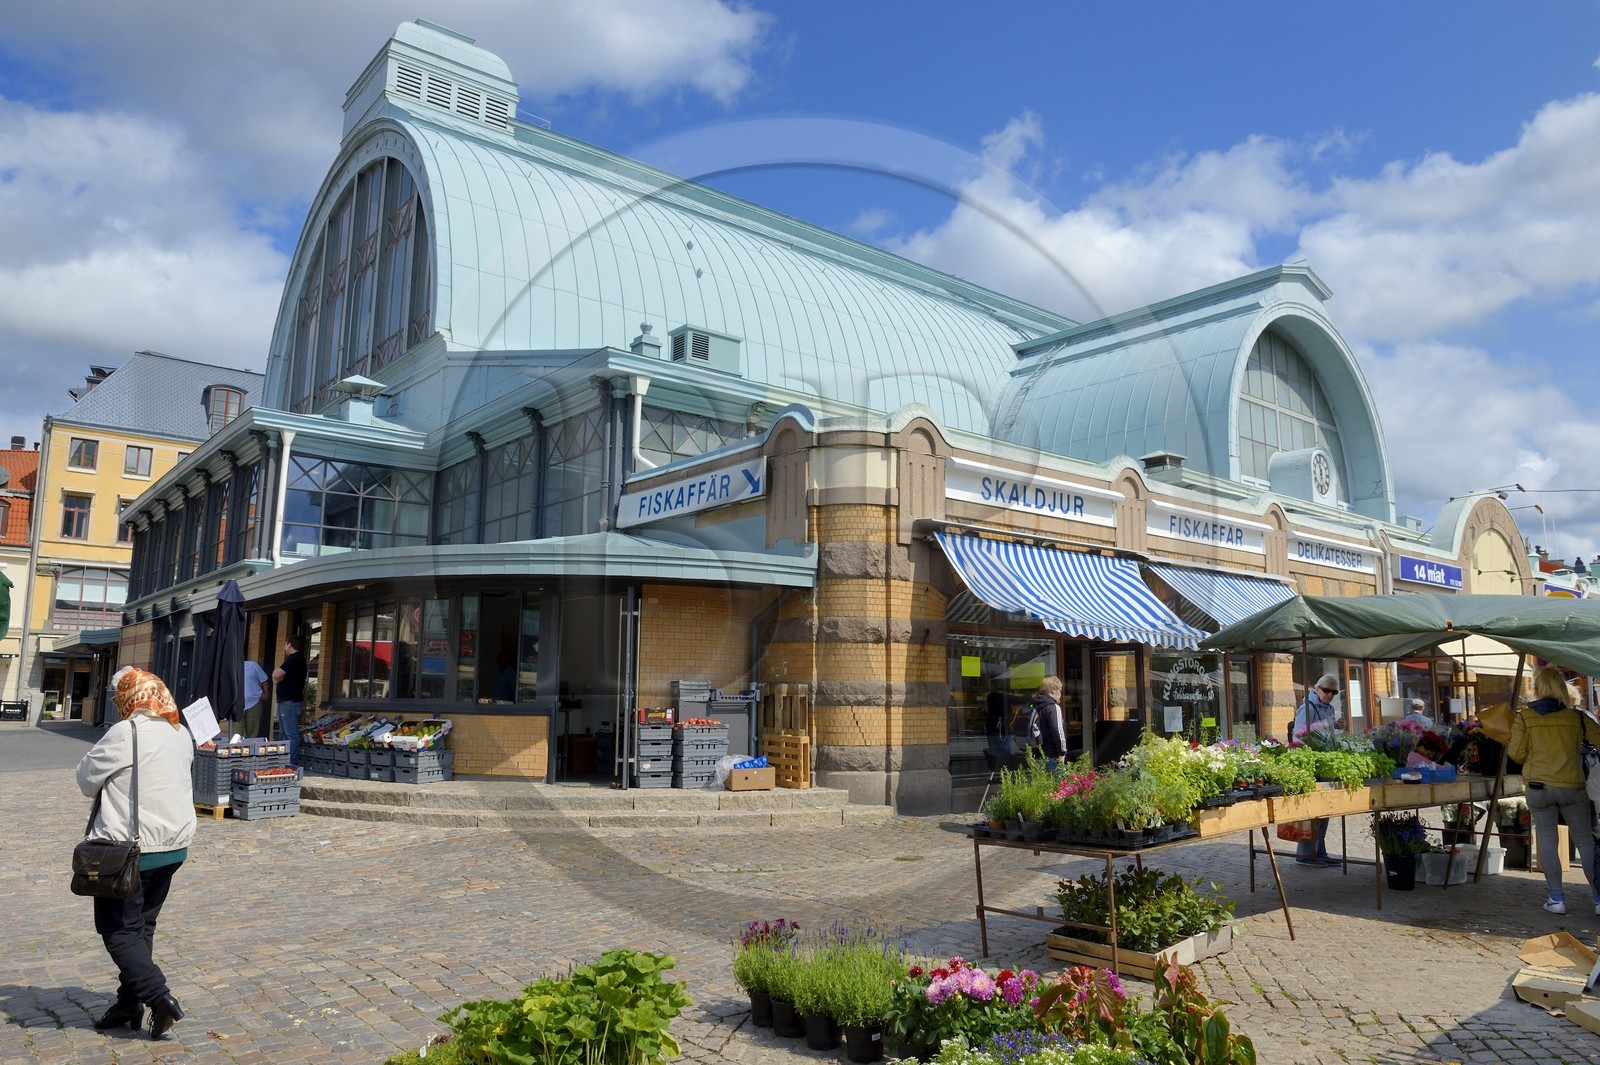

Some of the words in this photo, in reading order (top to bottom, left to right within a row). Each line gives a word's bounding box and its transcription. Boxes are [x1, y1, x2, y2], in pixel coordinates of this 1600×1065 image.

[638, 473, 731, 518] FISKAFFÄR
[980, 476, 1085, 517] SKALDJUR
[1169, 513, 1244, 547] FISKAFFÄR
[1297, 541, 1363, 568] DELIKATESSER
[1413, 564, 1427, 581] 14
